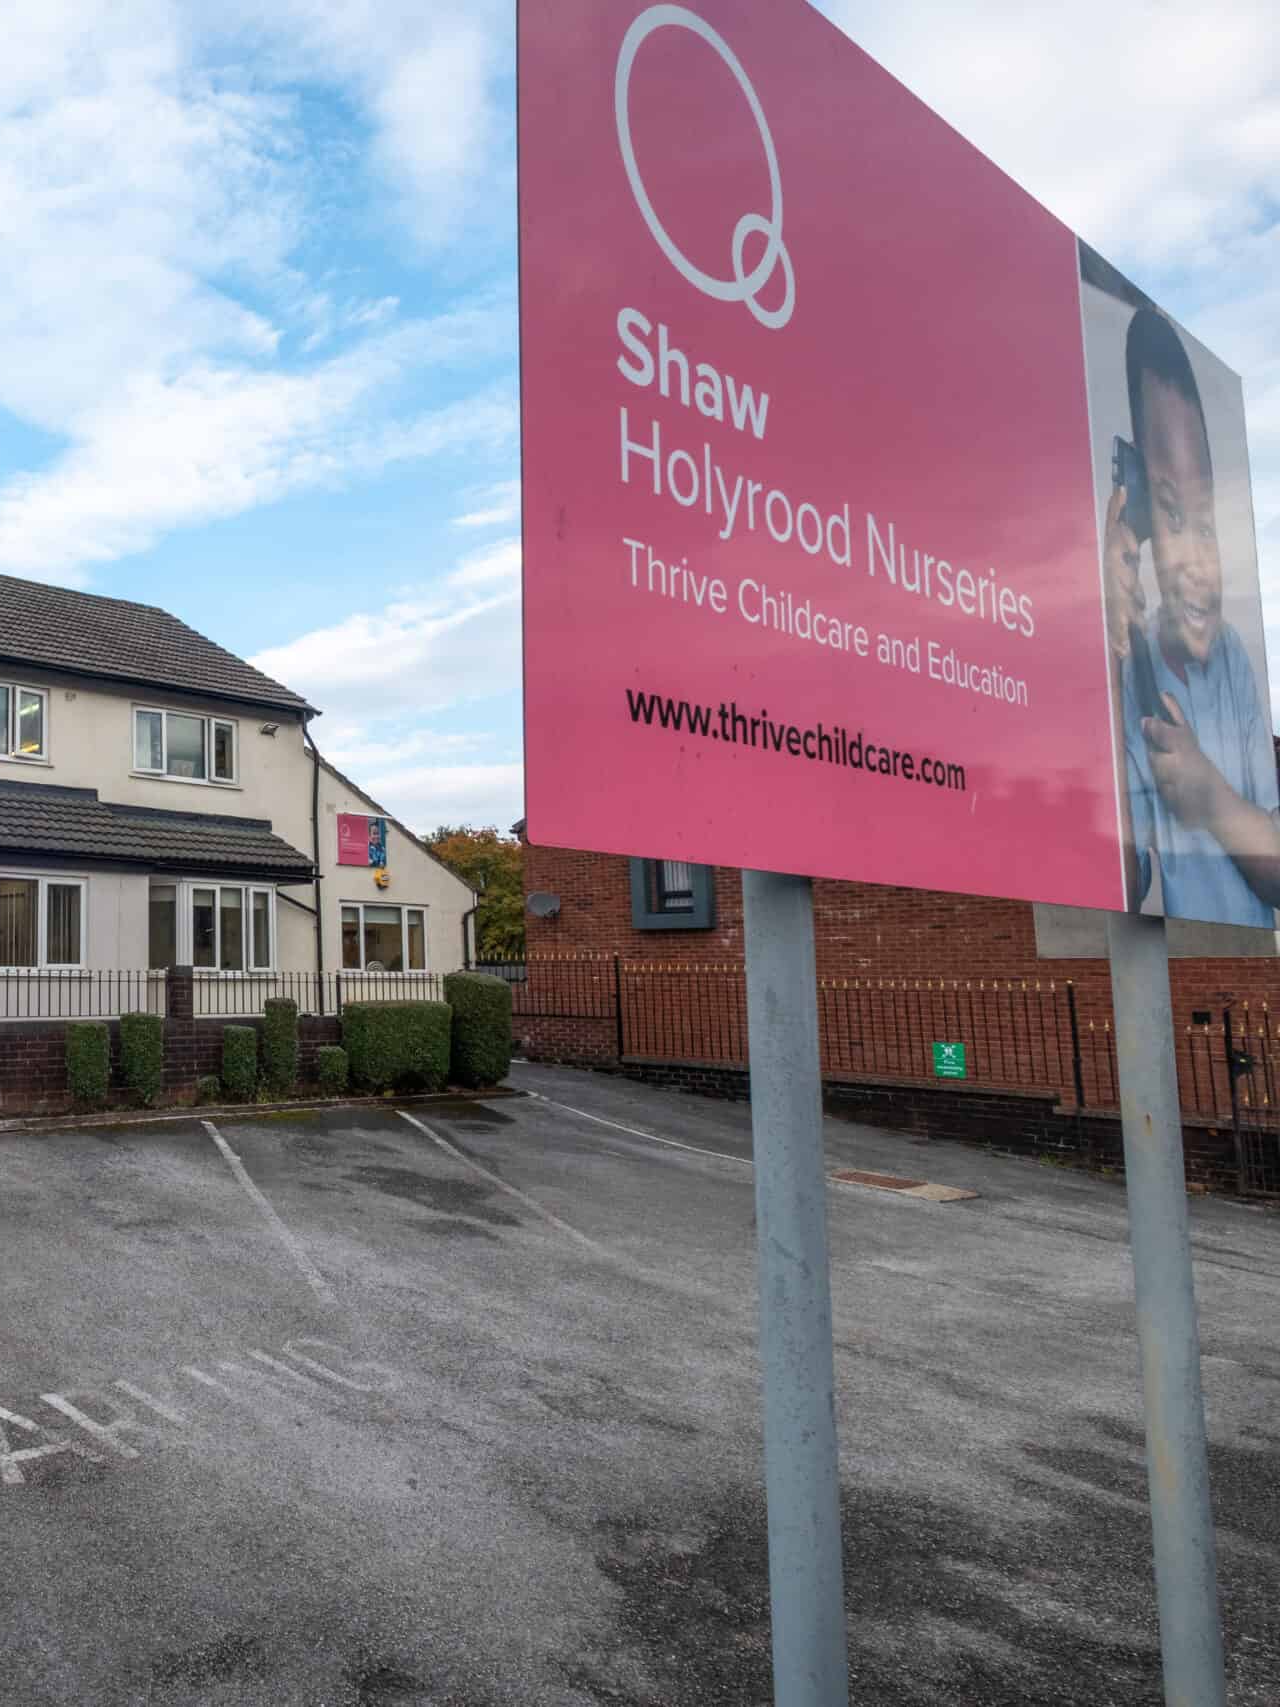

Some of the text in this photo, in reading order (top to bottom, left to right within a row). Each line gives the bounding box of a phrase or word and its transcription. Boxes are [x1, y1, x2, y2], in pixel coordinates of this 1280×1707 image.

[617, 307, 769, 440] Shaw
[620, 407, 1035, 637] Holyrood Nurseries
[623, 537, 1028, 707] Thrive Childcare and Education
[626, 687, 966, 792] www.thrivechildcare.com
